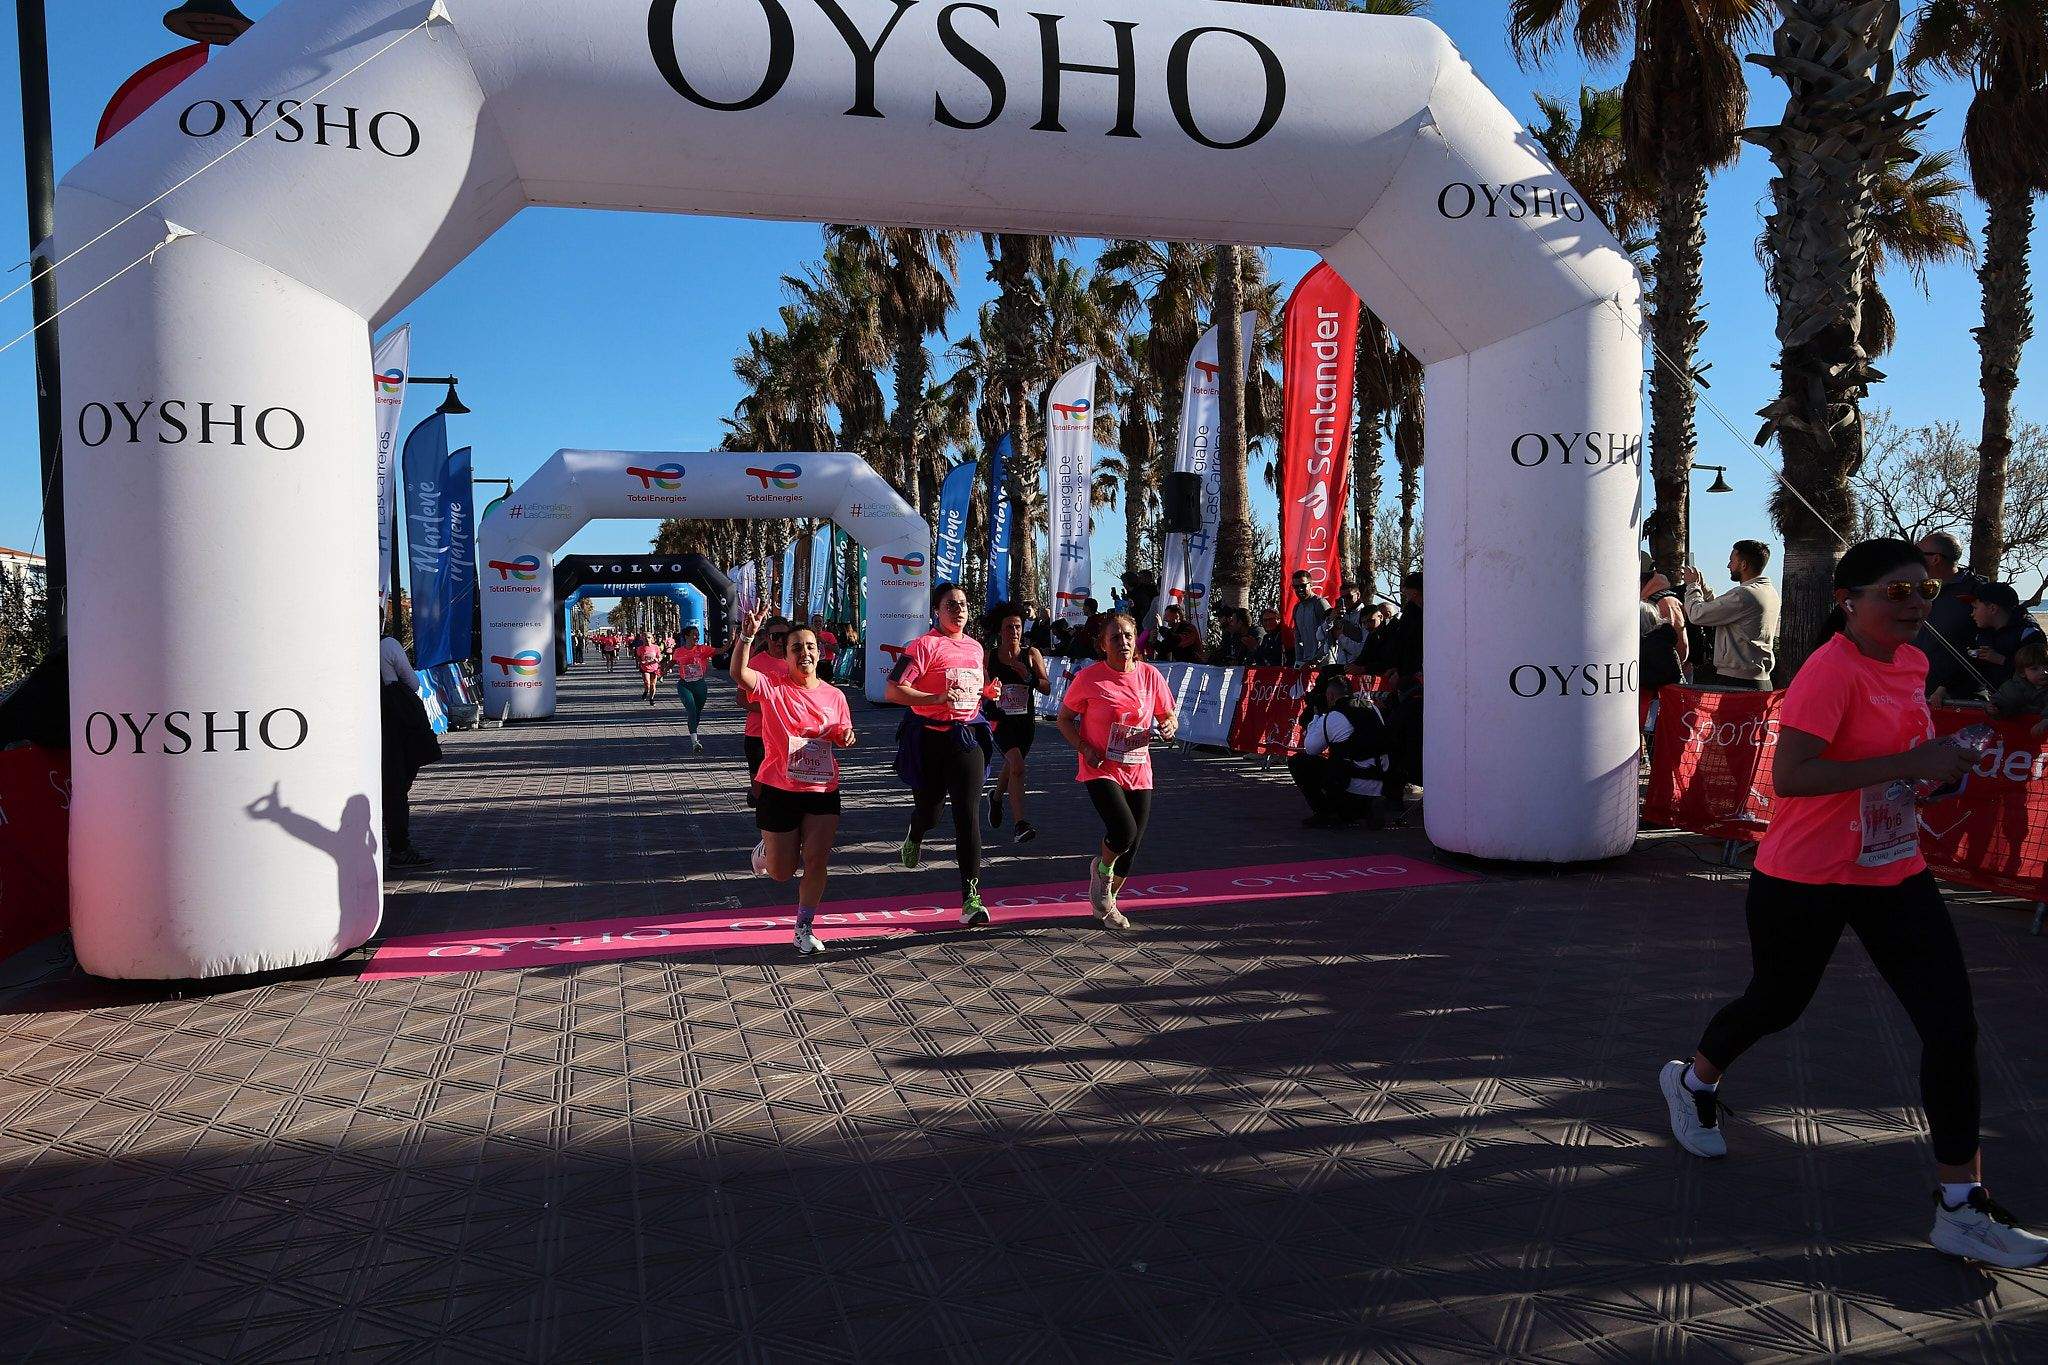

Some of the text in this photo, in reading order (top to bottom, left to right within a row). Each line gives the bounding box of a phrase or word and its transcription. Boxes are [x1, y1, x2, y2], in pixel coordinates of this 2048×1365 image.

[647, 0, 1286, 150] OYSHO
[179, 99, 421, 158] OYSHO
[1437, 182, 1585, 223] OYSHO
[1307, 306, 1339, 475] Santander
[78, 400, 306, 451] OYSHO
[1510, 431, 1642, 467] OYSHO
[627, 494, 687, 504] TotalEnergies
[746, 494, 803, 503] TotalEnergies
[409, 481, 449, 573] Marlene
[936, 509, 963, 581] Marlene
[590, 564, 682, 573] VOLVO
[881, 579, 925, 587] TotalEnergies
[489, 585, 541, 593] TotalEnergies
[491, 680, 542, 688] TotalEnergies
[1250, 680, 1289, 702] Sports
[1509, 660, 1639, 698] OYSHO
[86, 707, 309, 756] OYSHO
[1680, 711, 1778, 753] Sports
[1231, 866, 1409, 890] OYSHO
[729, 906, 945, 931] OSHO
[427, 928, 671, 958] OYSHO
